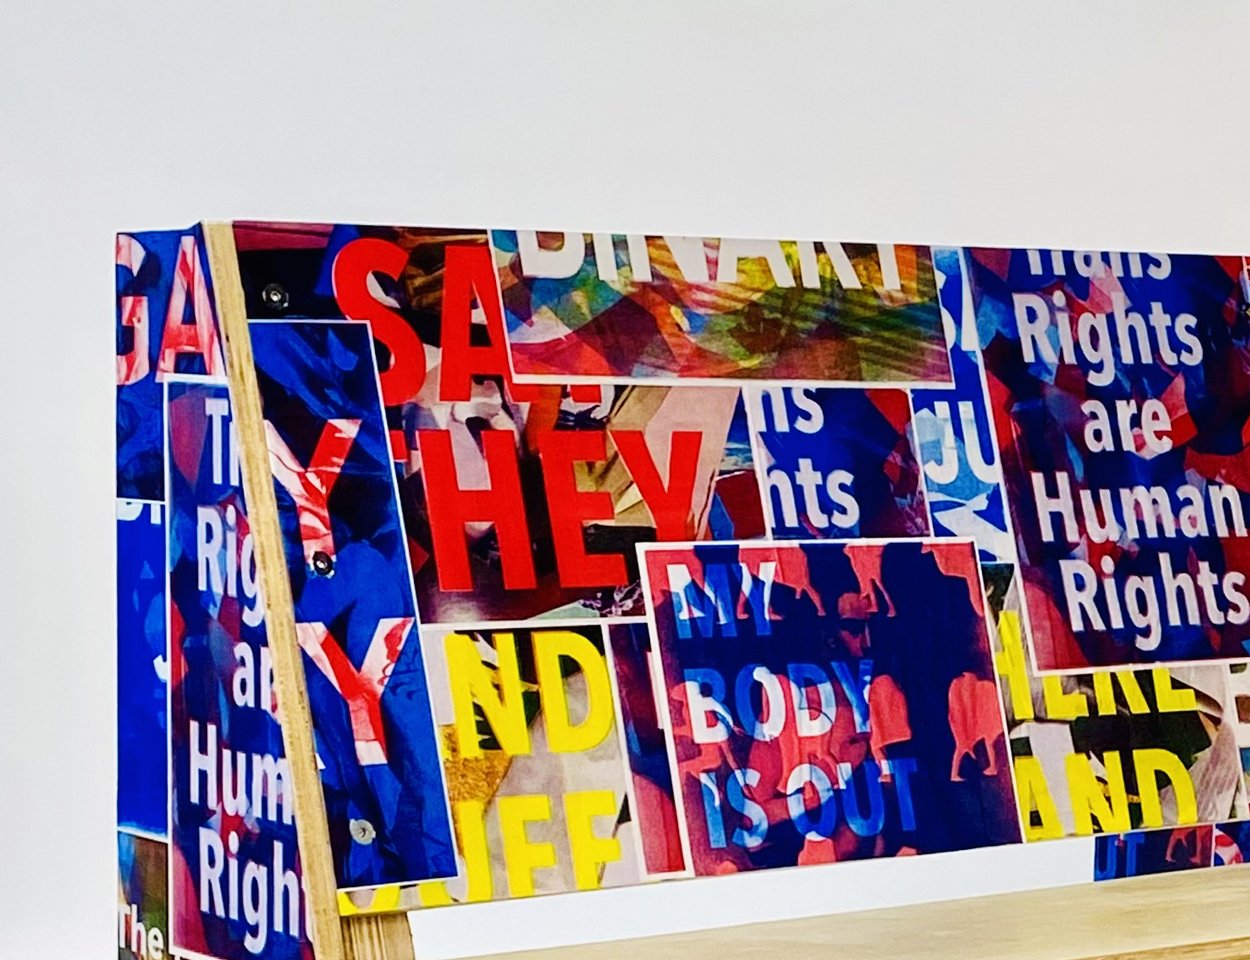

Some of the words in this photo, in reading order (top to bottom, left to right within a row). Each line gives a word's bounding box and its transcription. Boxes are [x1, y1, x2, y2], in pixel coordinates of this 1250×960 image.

[333, 238, 602, 405] SA
[1011, 290, 1204, 387] Rights
[1080, 398, 1174, 454] are
[1029, 470, 1248, 543] Human
[666, 560, 779, 640] MY
[683, 658, 876, 744] BODY
[702, 767, 769, 850] IS
[785, 757, 919, 840] OUT
